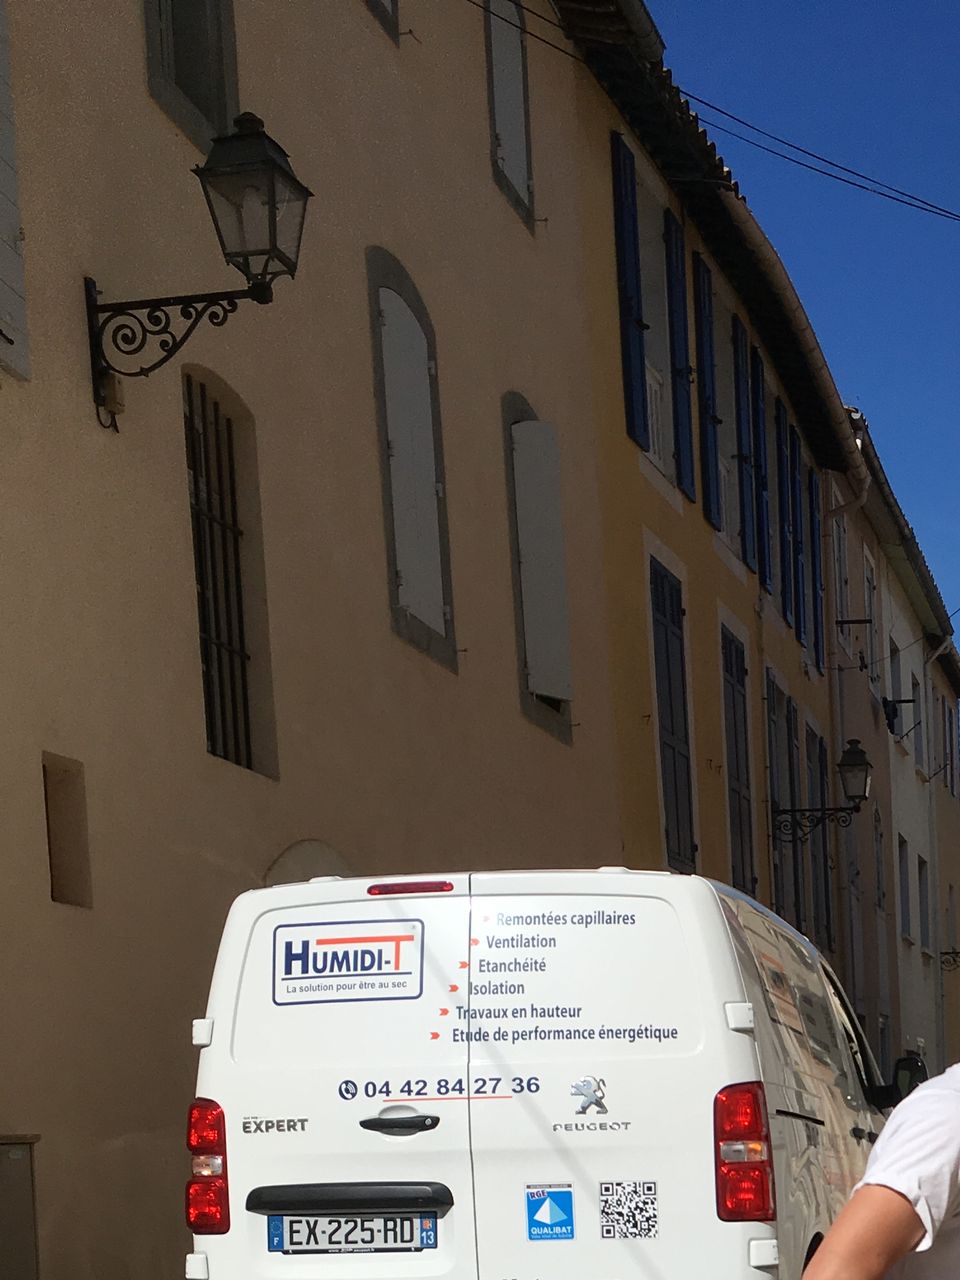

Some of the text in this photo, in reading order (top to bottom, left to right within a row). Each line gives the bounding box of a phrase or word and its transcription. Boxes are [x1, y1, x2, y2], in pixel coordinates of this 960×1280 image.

[496, 910, 636, 928] Remontées capillaires
[486, 934, 557, 949] Ventilation
[284, 935, 414, 976] HUMIDI-T
[479, 957, 547, 973] Etanchéité
[286, 985, 297, 994] La
[299, 983, 334, 993] solution
[336, 983, 356, 992] pour
[359, 980, 375, 989] être
[468, 980, 525, 995] Isolation
[456, 1003, 582, 1019] Travaux en hauteur
[453, 1025, 678, 1044] Etude de performance énergétique
[364, 1077, 540, 1098] 04 42 84 27 36
[242, 1118, 309, 1133] EXPERT
[552, 1122, 631, 1132] PEUGEOT
[529, 1190, 548, 1200] RGE
[289, 1217, 414, 1245] EX-225-RD
[421, 1231, 434, 1244] 13
[530, 1226, 572, 1234] QUALIBAT
